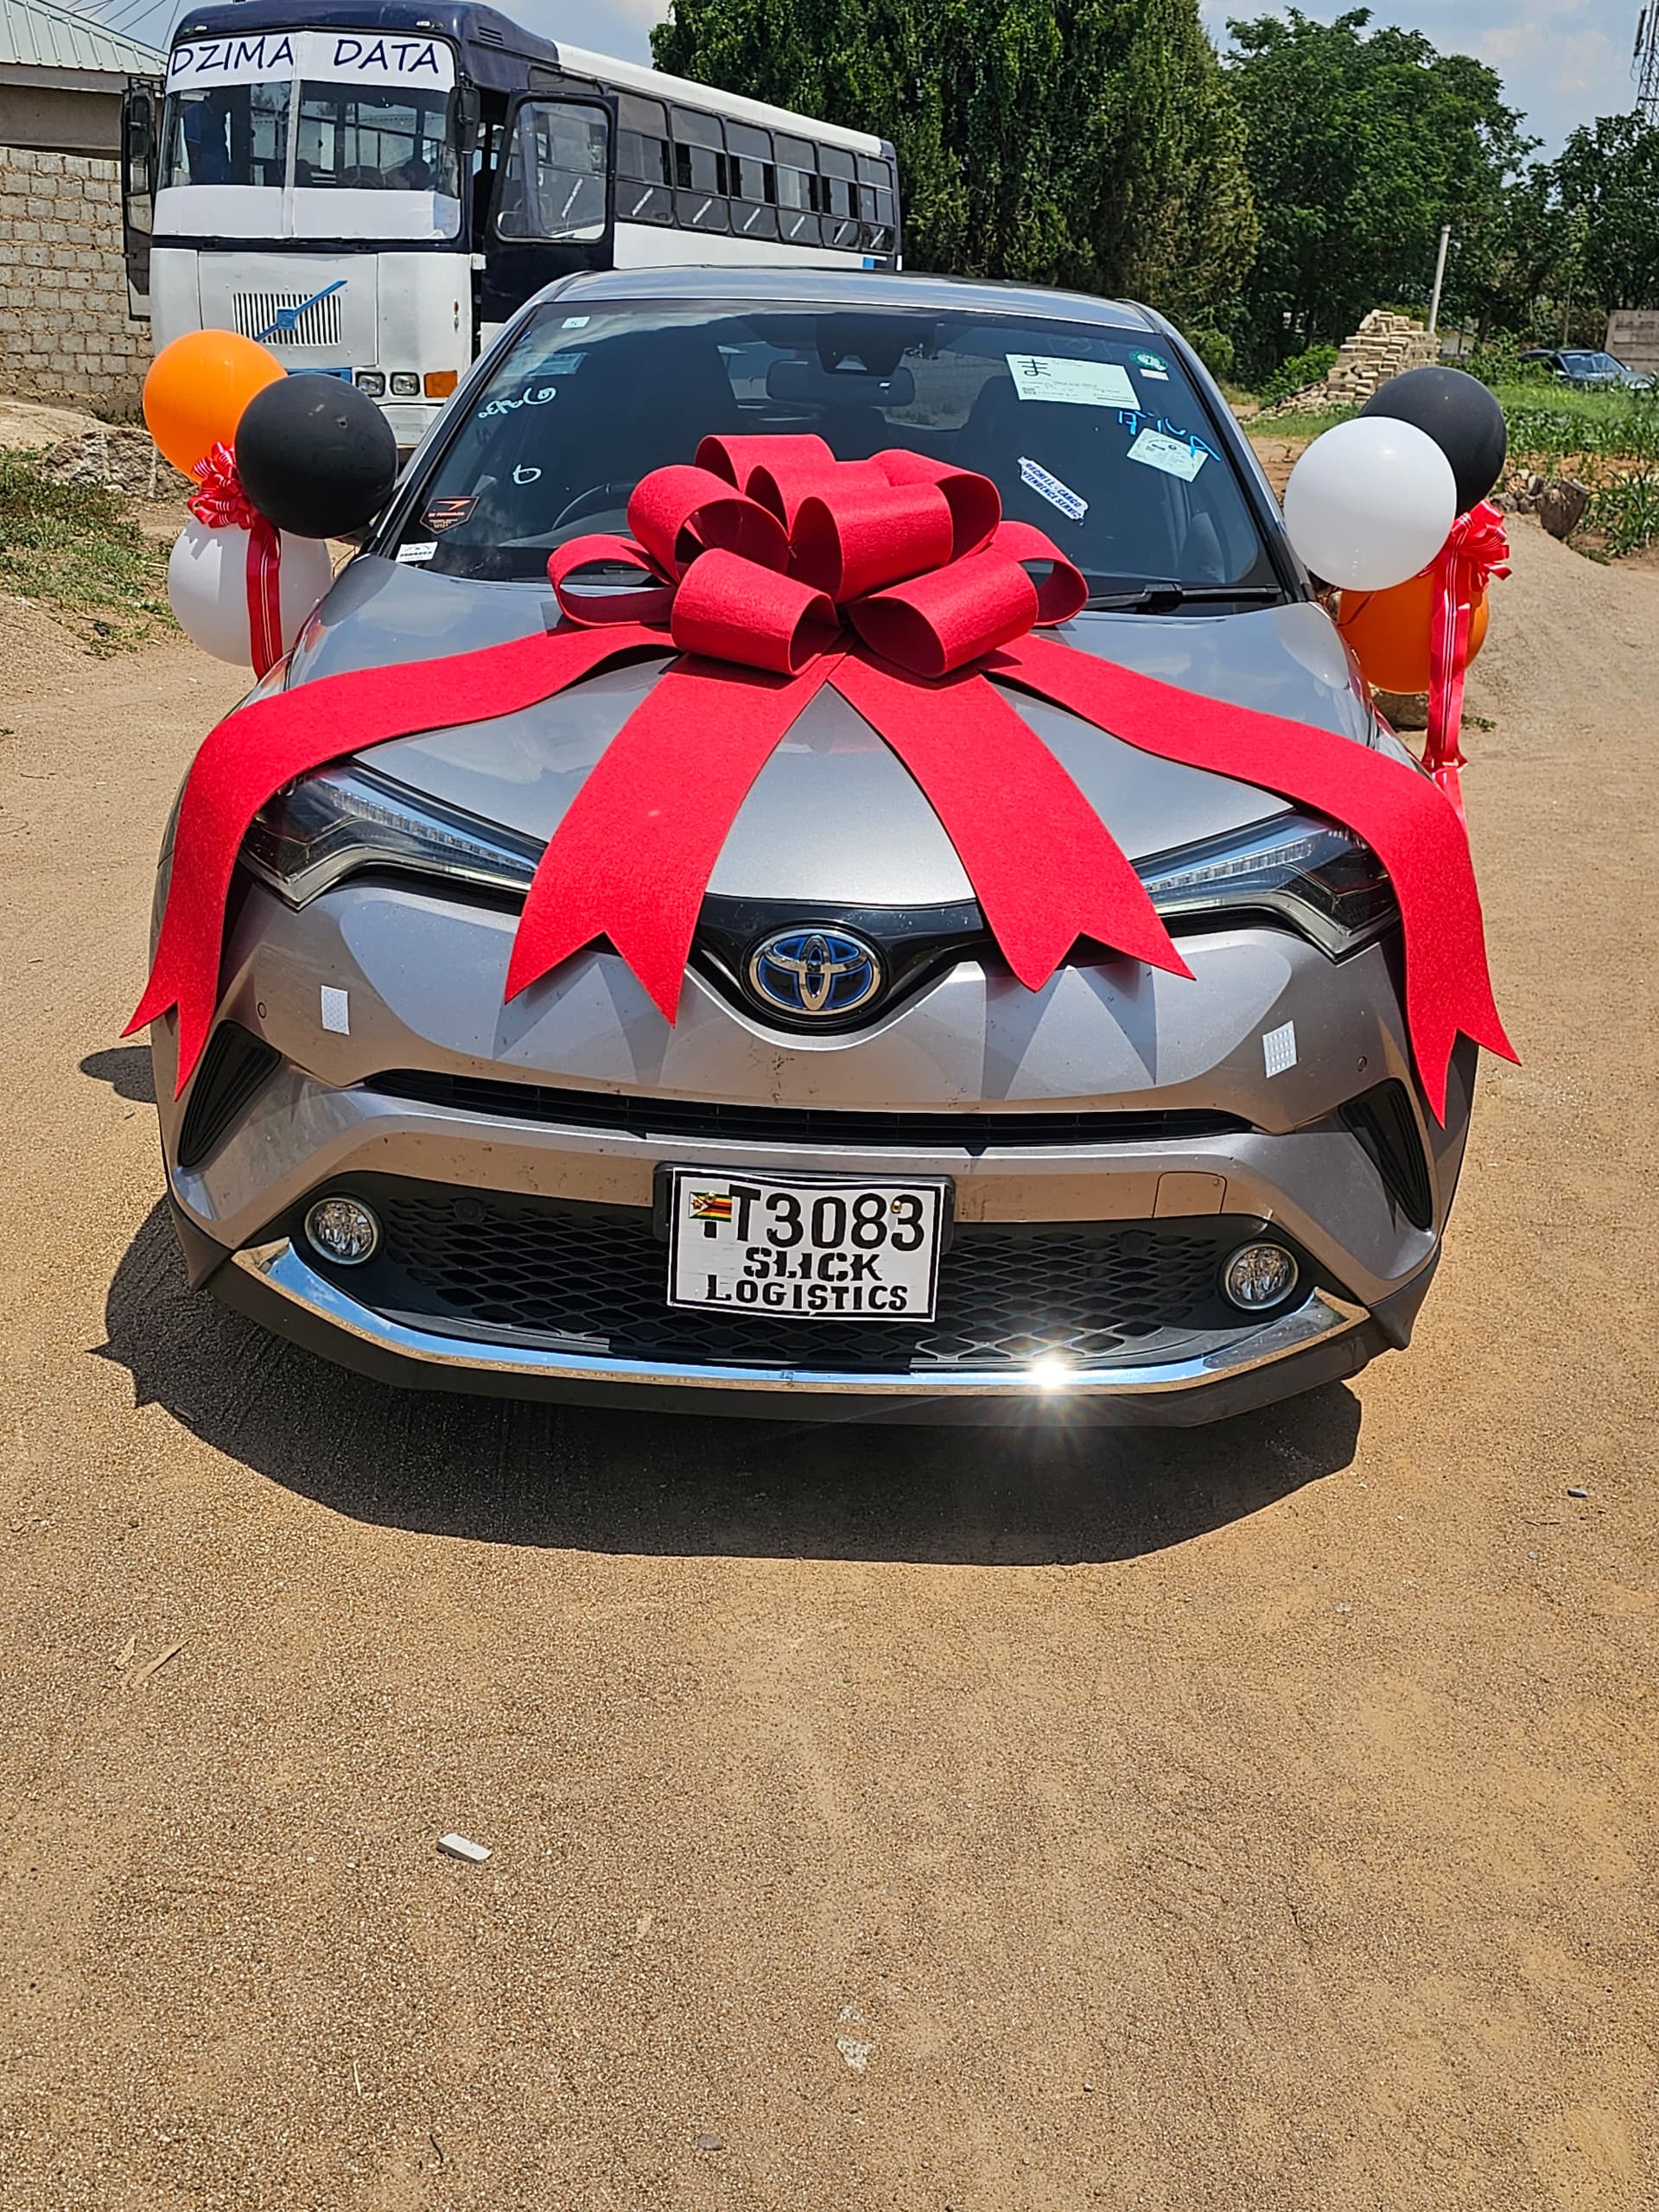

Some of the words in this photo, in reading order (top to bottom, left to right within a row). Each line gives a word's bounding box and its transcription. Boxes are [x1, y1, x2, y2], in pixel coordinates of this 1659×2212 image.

[172, 36, 294, 76] DZIMA
[334, 39, 439, 74] DATA
[743, 1246, 883, 1282] SLICK
[704, 1274, 908, 1312] LOGISTICS
